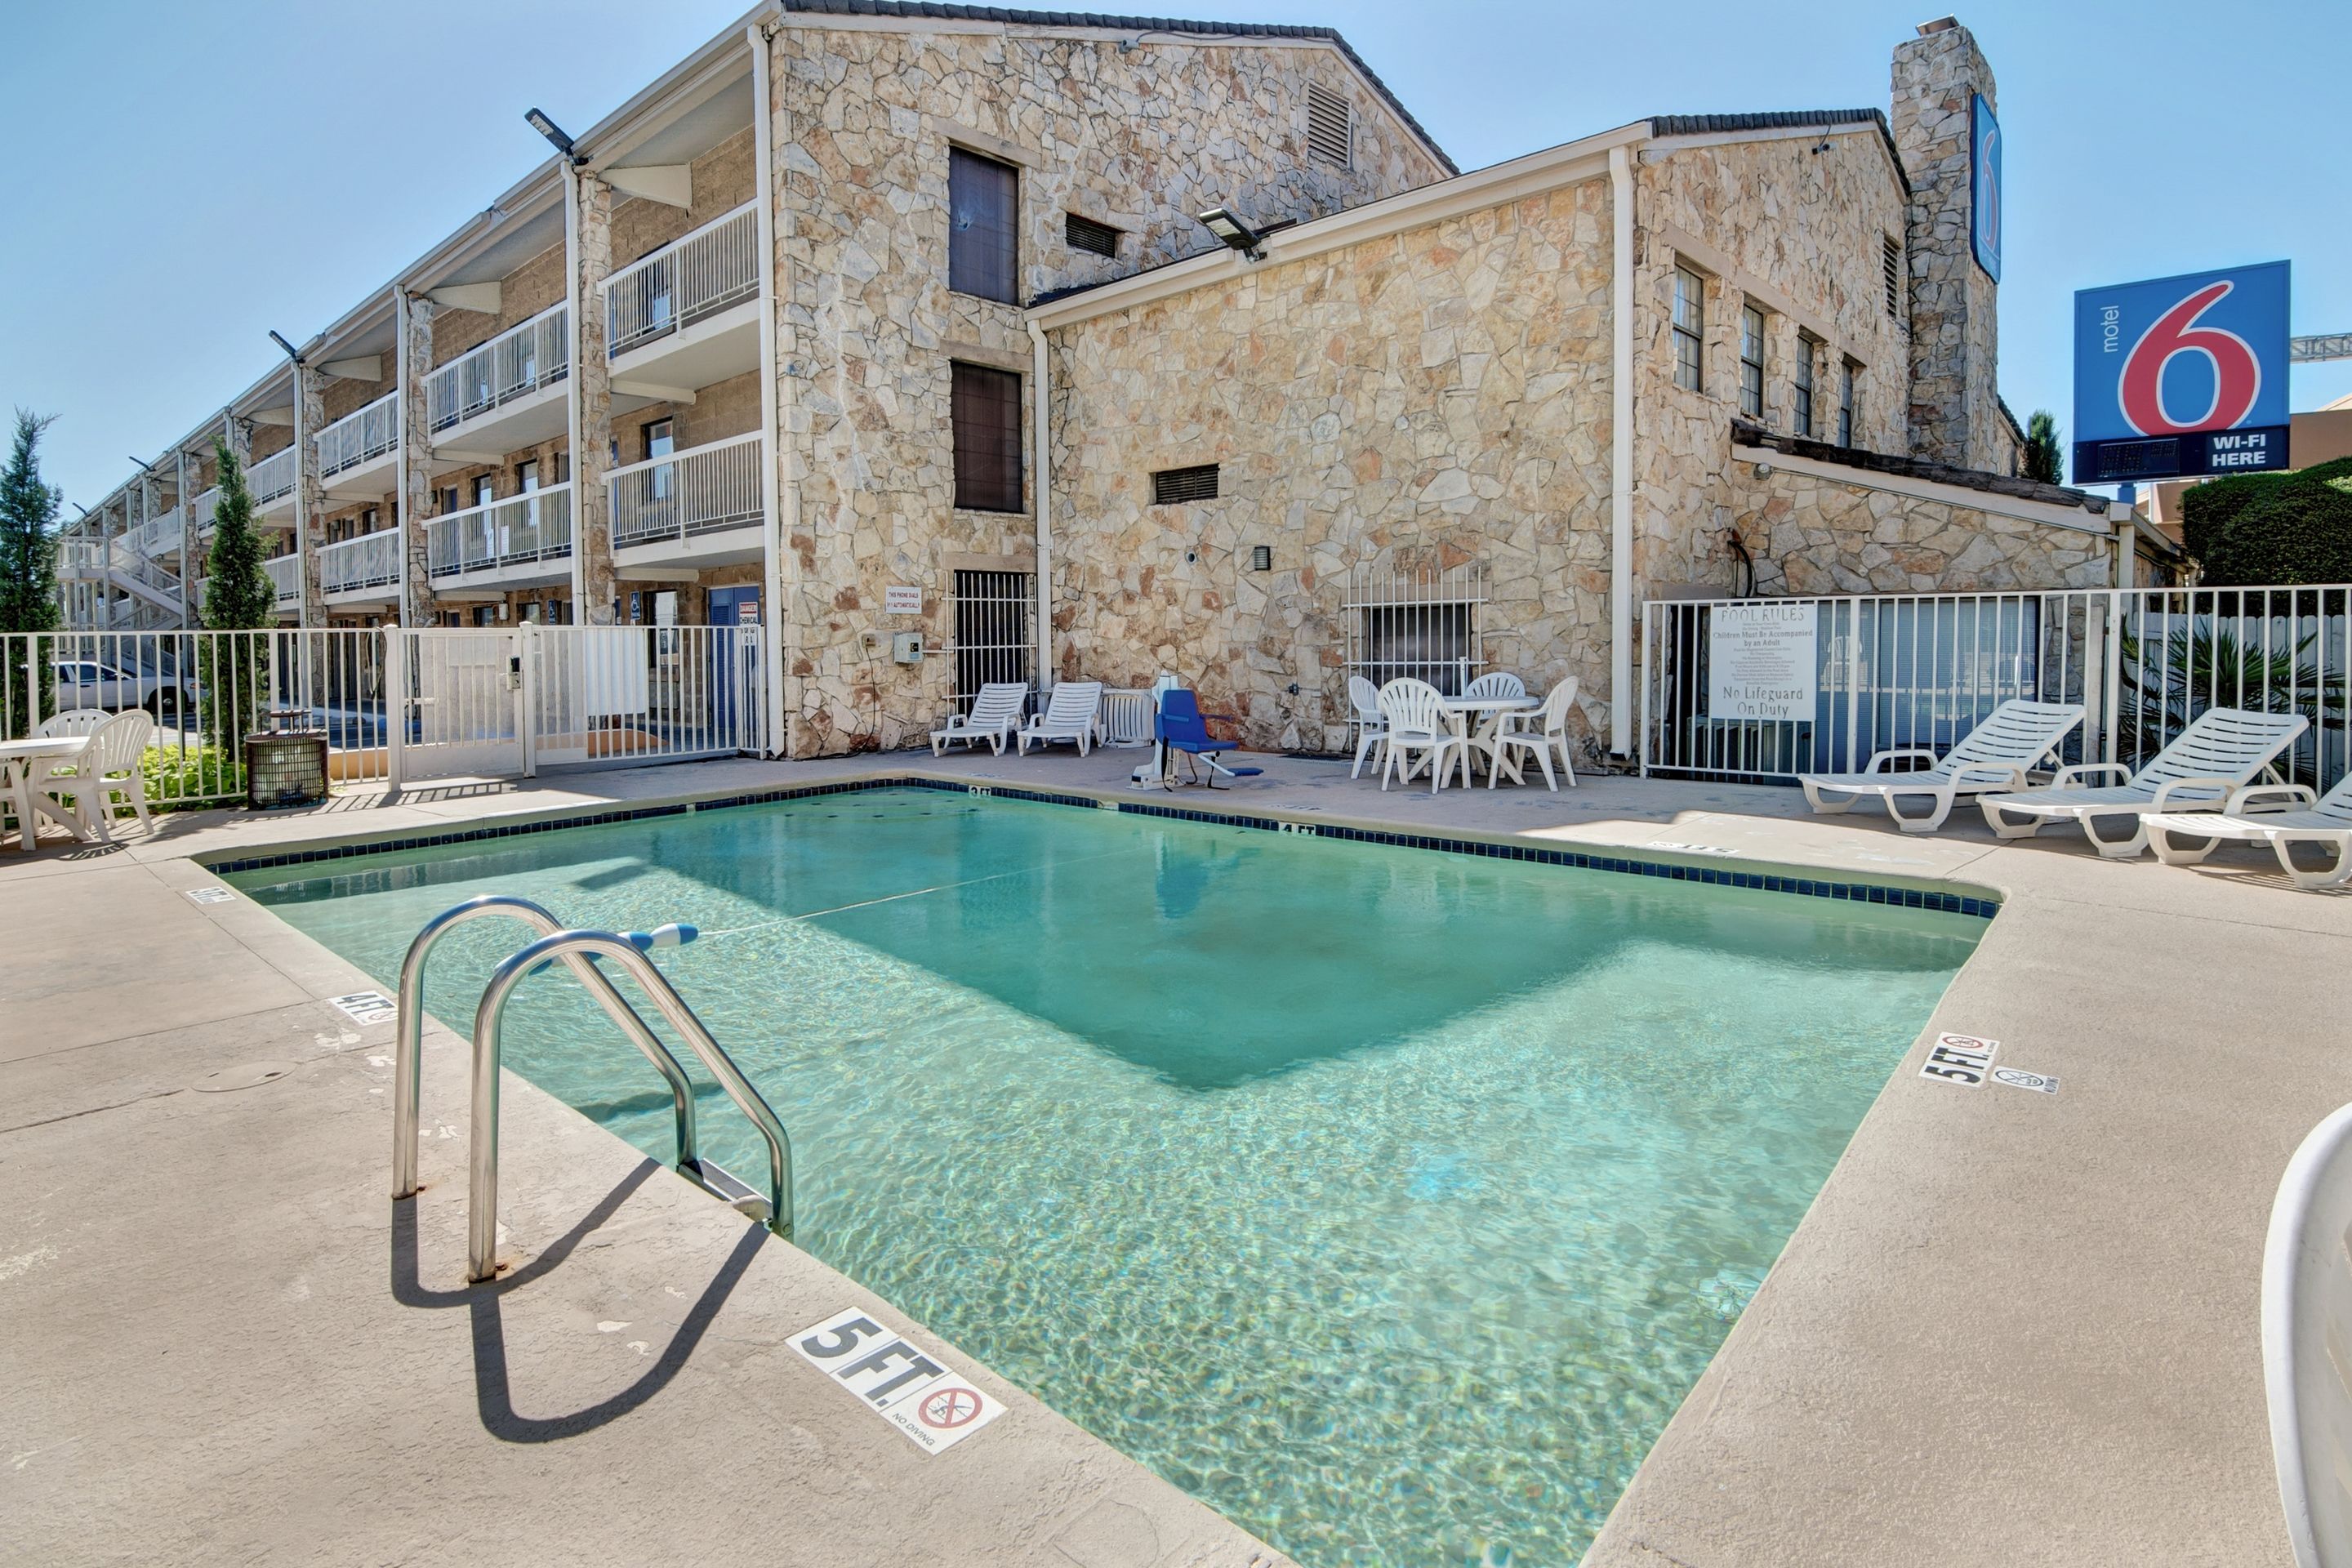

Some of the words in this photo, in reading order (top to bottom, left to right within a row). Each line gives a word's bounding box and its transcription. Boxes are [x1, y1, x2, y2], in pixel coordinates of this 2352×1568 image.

[1980, 129, 1998, 252] 6
[2100, 305, 2119, 353] motel
[2118, 279, 2261, 436] 6
[2213, 434, 2266, 450] WI-FI
[2212, 451, 2266, 466] HERE
[1722, 608, 1757, 621] POOL
[1762, 608, 1804, 621] RULES
[1770, 630, 1813, 639] Accompanied
[1723, 686, 1740, 699] No
[1744, 686, 1803, 702] Lifeguard
[1737, 702, 1755, 715] On
[1760, 702, 1789, 719] Duty
[1924, 1066, 1981, 1084] 5
[800, 1316, 884, 1358] 5
[892, 1413, 907, 1424] NO
[906, 1423, 935, 1446] DIVING
